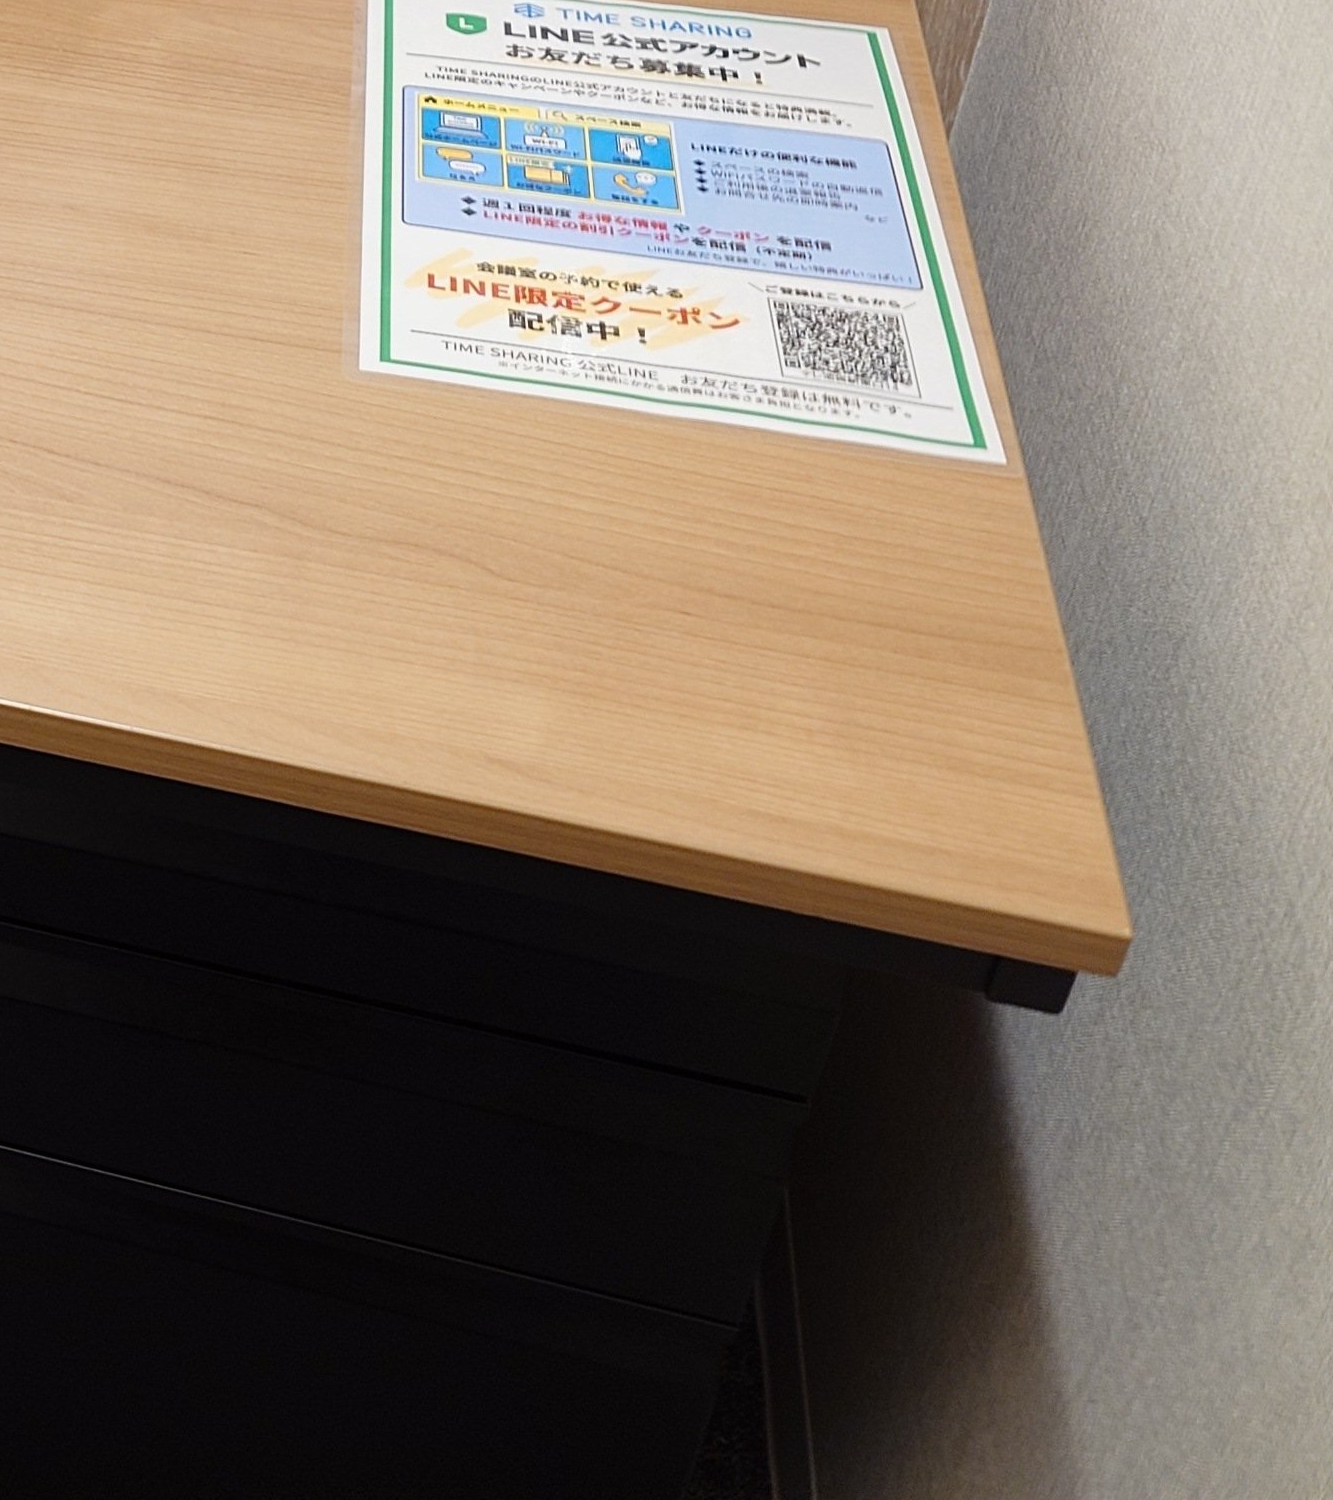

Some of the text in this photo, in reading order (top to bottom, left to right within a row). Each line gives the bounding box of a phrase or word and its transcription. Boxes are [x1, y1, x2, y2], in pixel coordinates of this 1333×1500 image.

[556, 7, 753, 40] TIME SHARING
[505, 42, 764, 86] お友だち募集中！
[690, 142, 858, 170] LINEだけの便利な機能
[577, 210, 668, 232] お得な情報
[674, 223, 690, 233] や
[697, 225, 770, 243] クーポン
[776, 236, 832, 252] を配信
[476, 261, 684, 299] 会議室の予約で使える
[427, 272, 742, 331] LINE限定クーポン
[508, 308, 647, 344] 配信中！
[442, 340, 486, 356] TIME
[490, 346, 572, 369] SHARING
[681, 374, 914, 419] お友だち登録は無料です。
